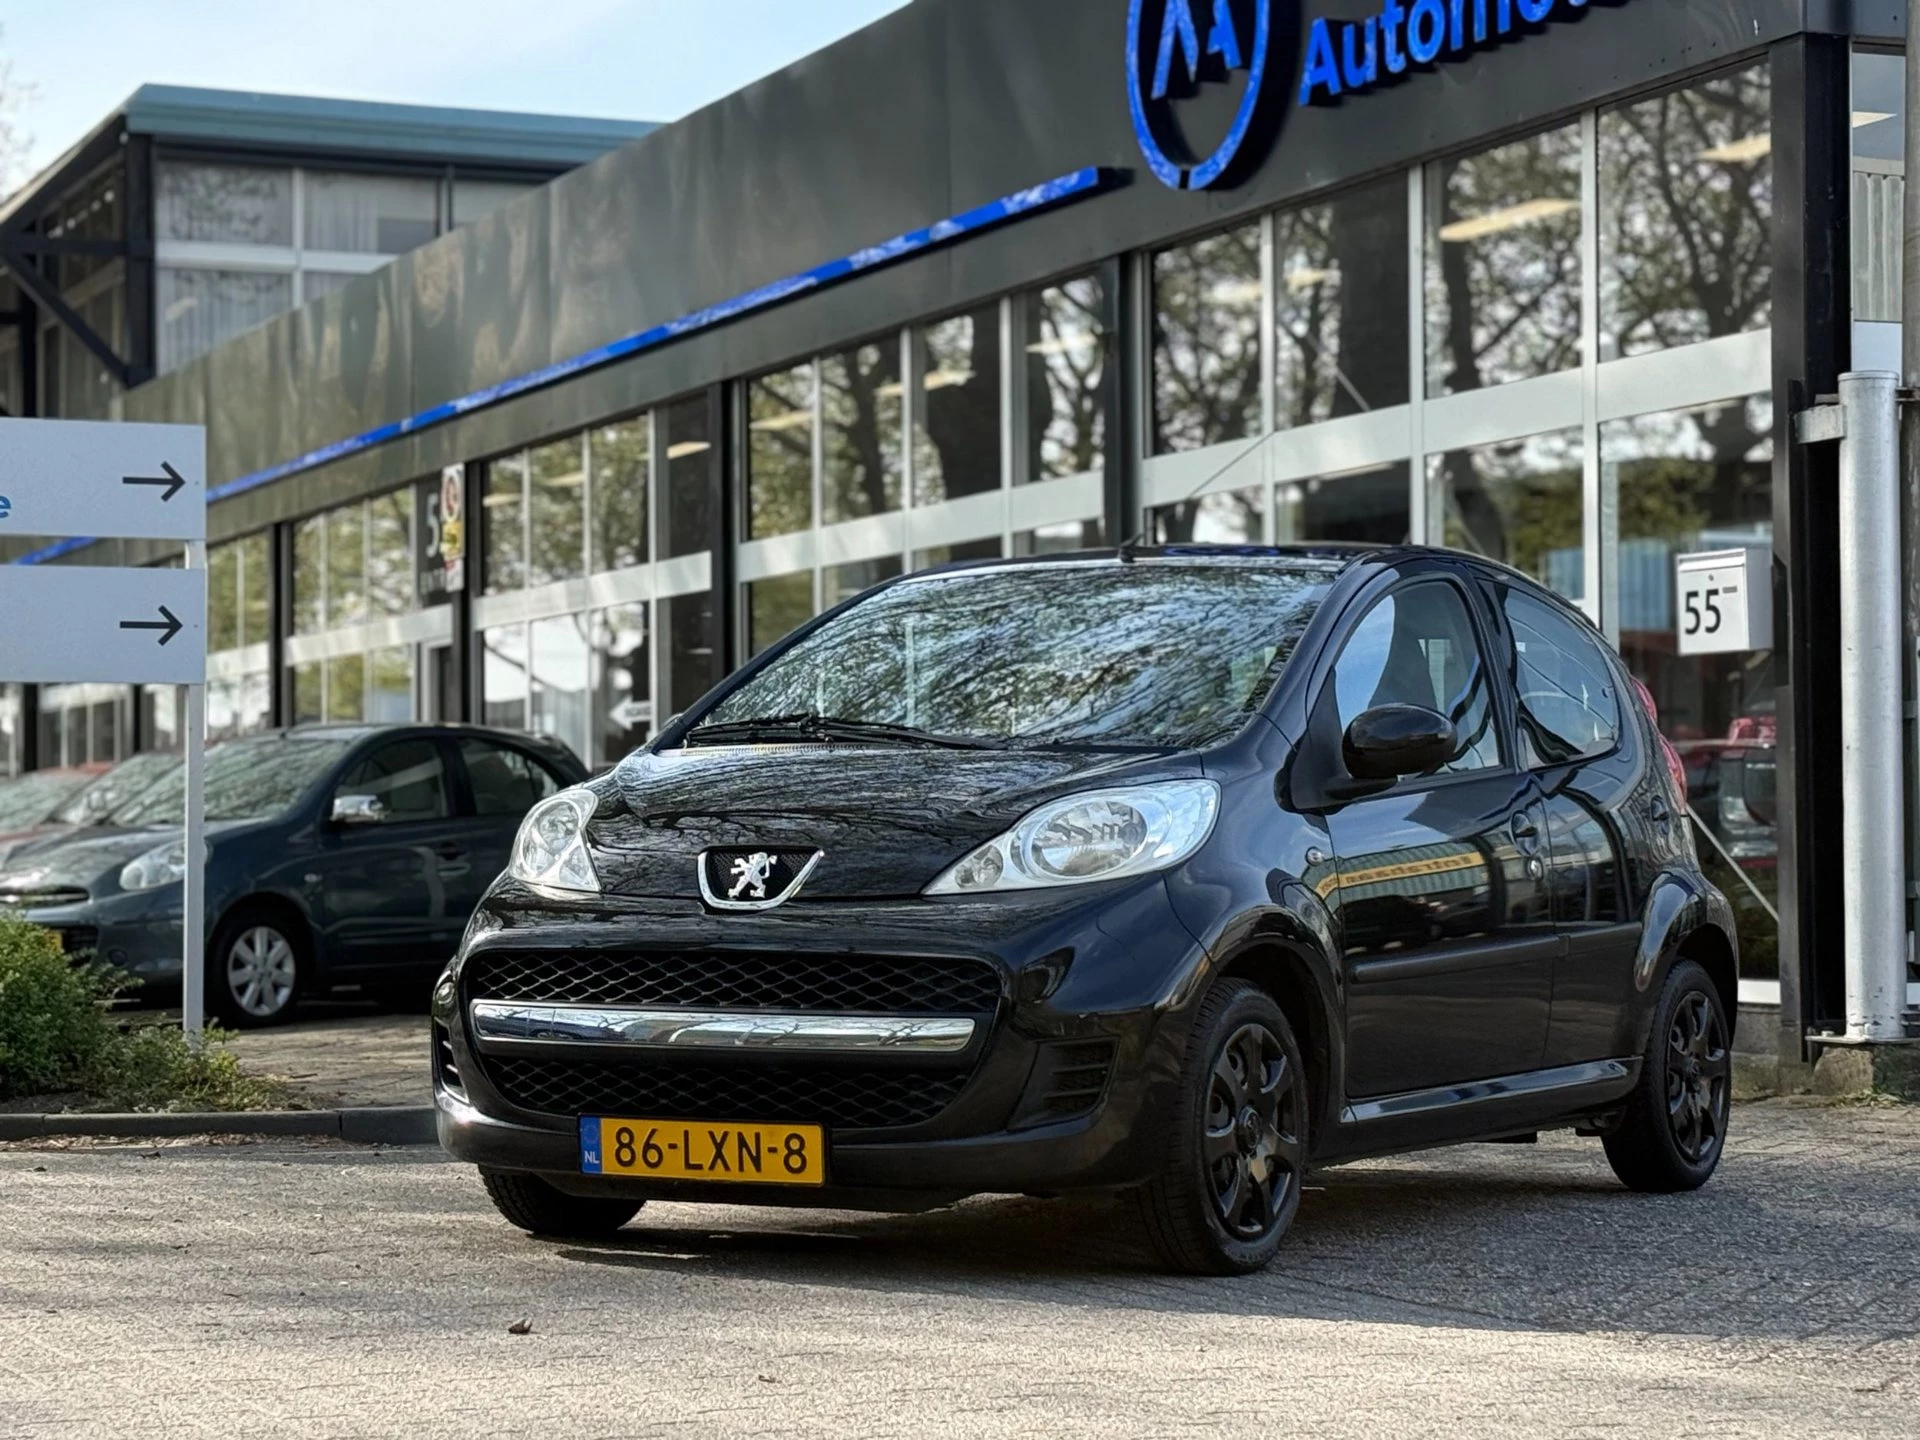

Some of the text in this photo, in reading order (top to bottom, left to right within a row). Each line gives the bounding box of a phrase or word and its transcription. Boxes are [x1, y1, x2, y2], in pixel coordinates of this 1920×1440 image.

[1299, 0, 1591, 107] Autom
[1685, 588, 1721, 635] 55
[584, 1126, 808, 1174] NL 86-LXN-8
